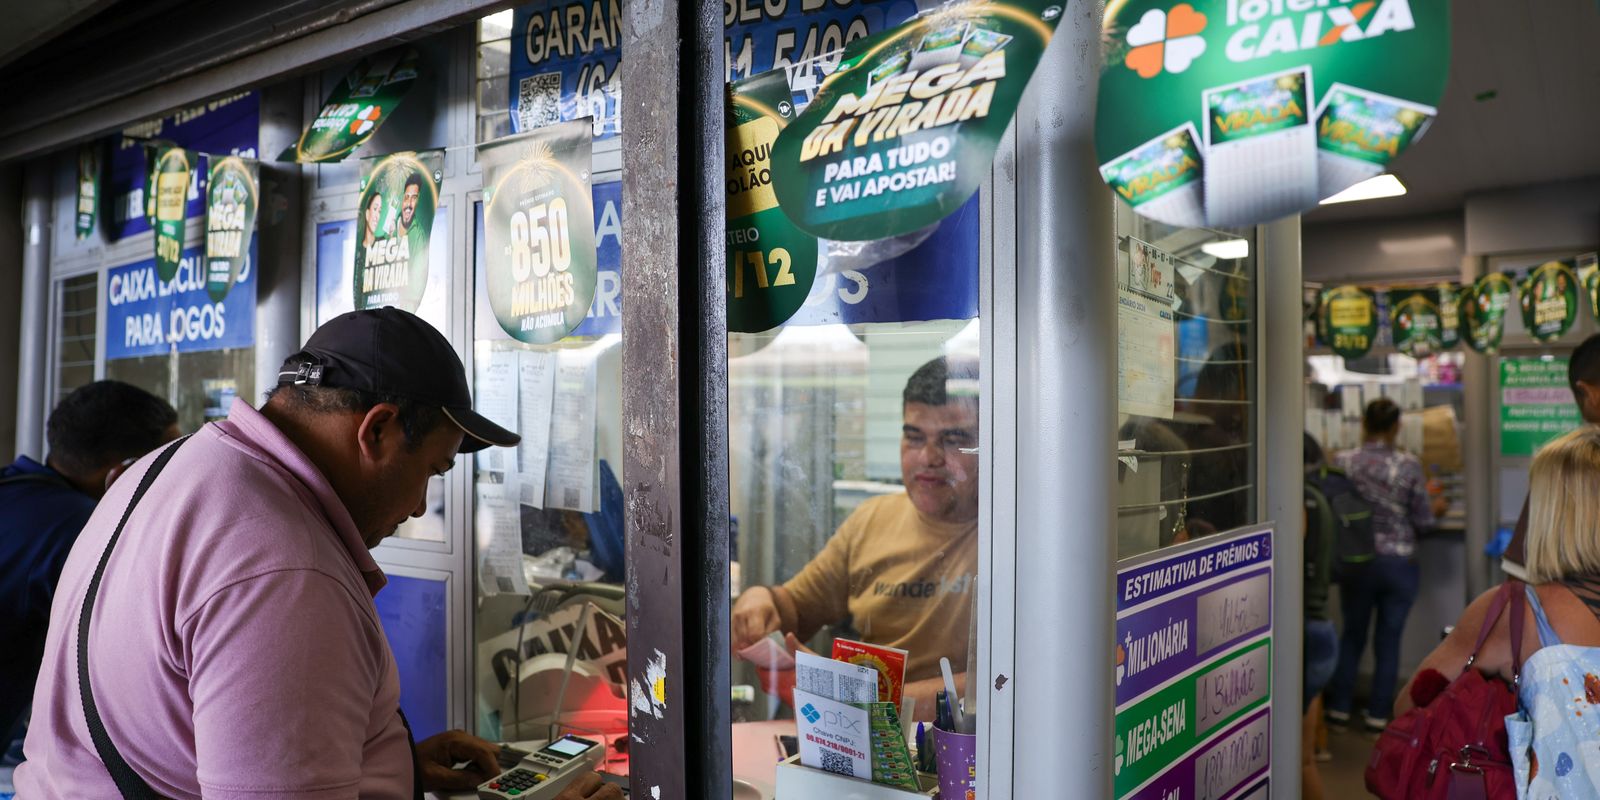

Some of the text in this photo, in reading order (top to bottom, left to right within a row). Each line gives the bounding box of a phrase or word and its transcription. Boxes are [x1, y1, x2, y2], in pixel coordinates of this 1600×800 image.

[1225, 0, 1415, 62] CAIXA
[821, 49, 1006, 125] MEGA
[800, 81, 996, 163] DA VIRADA
[1215, 100, 1303, 133] VIRADA
[732, 142, 770, 171] AQUI
[824, 136, 950, 184] PARA TUDO
[815, 160, 956, 208] E VAI APOSTAR!
[365, 235, 410, 267] MEGA
[510, 197, 571, 282] 850
[109, 267, 154, 305] CAIXA
[511, 271, 574, 317] MILHÕES
[727, 247, 796, 299] /12
[125, 302, 225, 347] PARA JOGOS
[521, 316, 534, 331] NÃO
[1125, 540, 1259, 601] ESTIMATIVA DE PRÊMIOS
[824, 710, 862, 735] pix
[1126, 698, 1186, 768] MEGA-SENA
